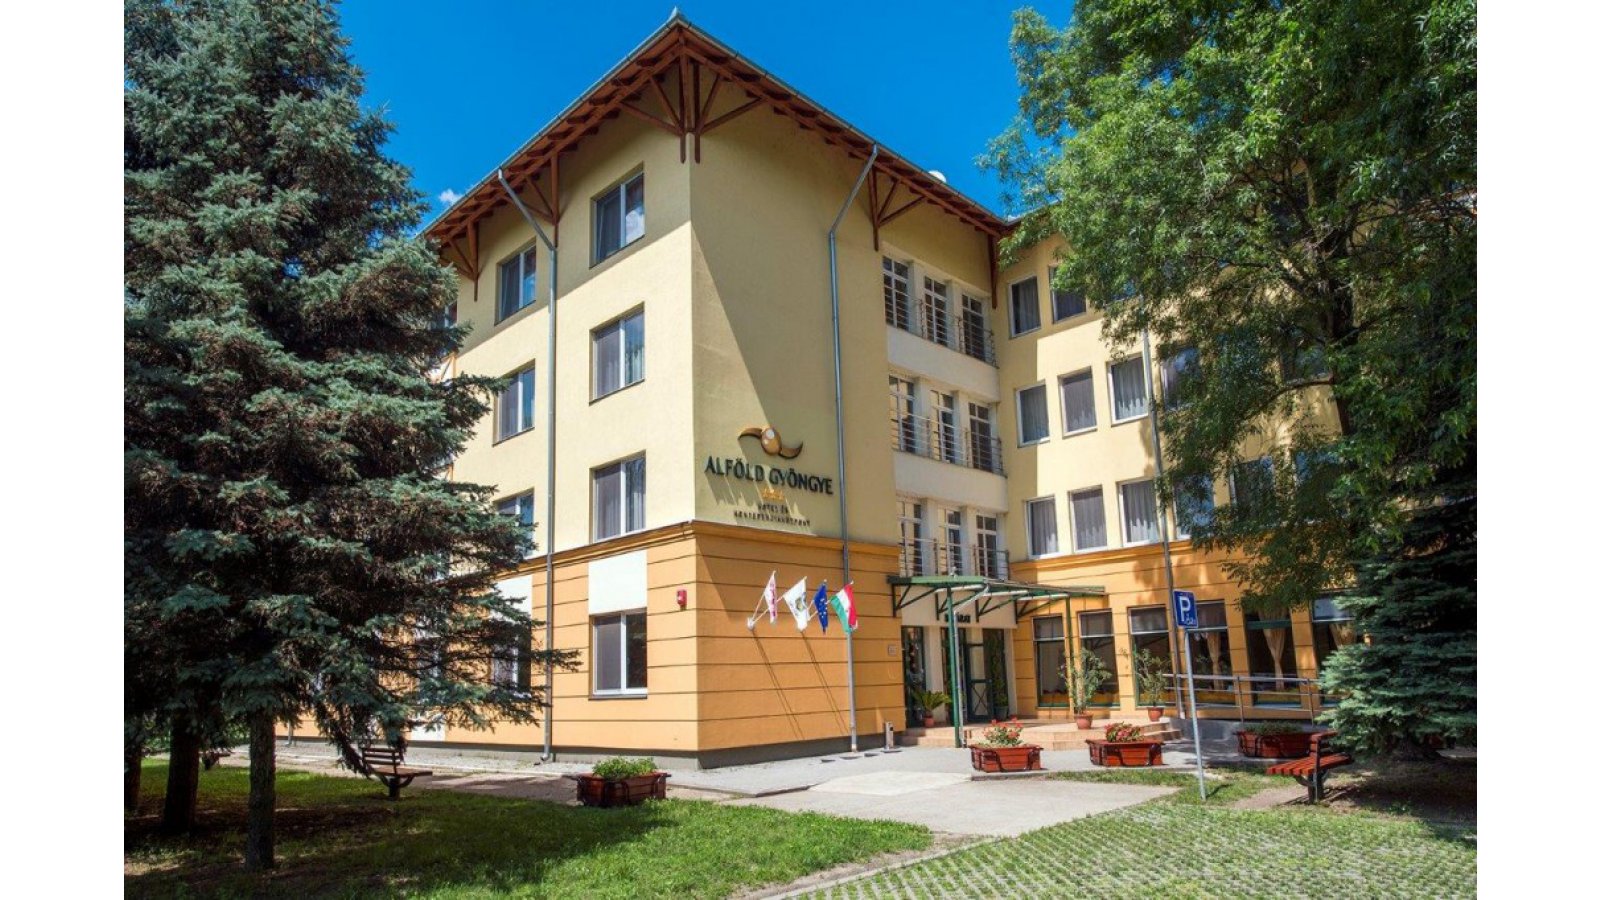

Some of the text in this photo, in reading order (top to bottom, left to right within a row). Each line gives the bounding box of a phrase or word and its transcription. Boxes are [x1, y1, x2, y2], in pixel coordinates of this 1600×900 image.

[705, 456, 833, 495] ALFÖLD GYÖNGYE
[1179, 595, 1191, 621] P
